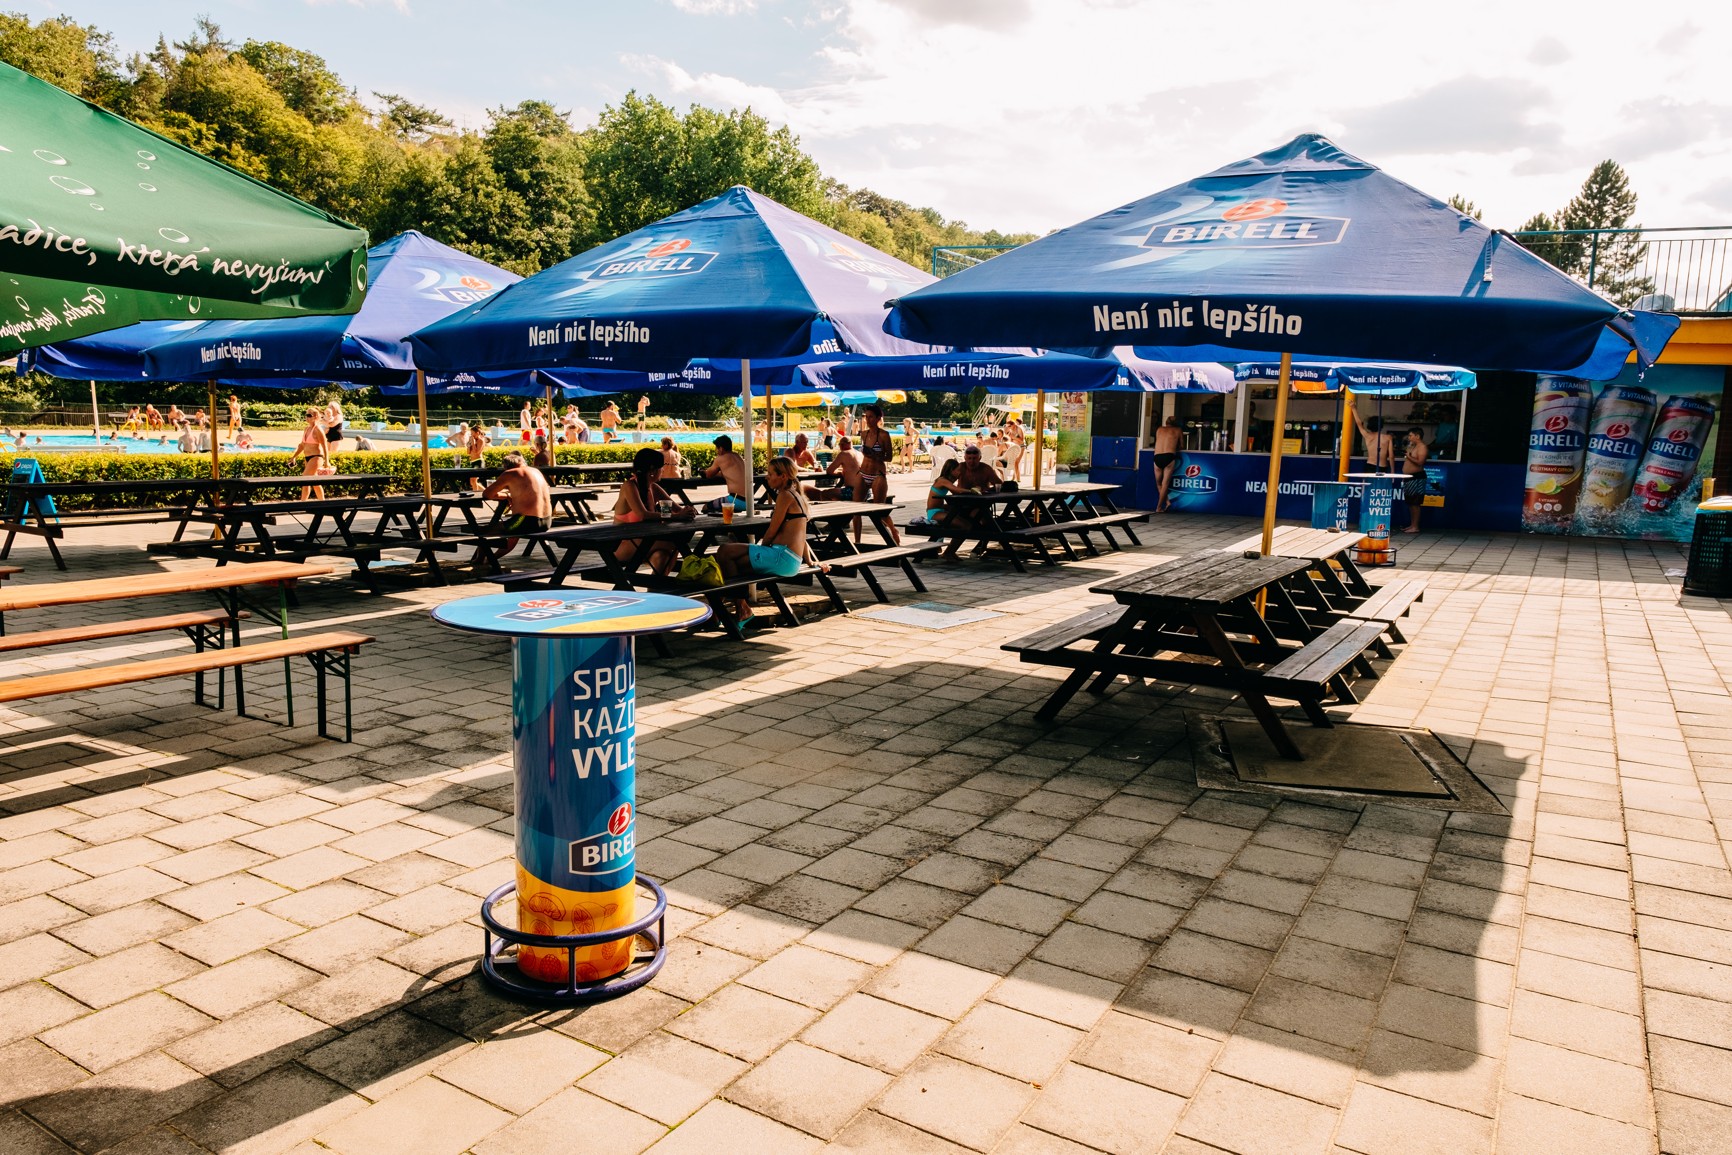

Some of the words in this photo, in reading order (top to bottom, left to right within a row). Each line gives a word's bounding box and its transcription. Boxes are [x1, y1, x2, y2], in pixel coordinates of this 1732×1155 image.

[1162, 222, 1321, 243] BIRELL
[117, 237, 210, 273] která
[212, 257, 332, 294] nevyšumí
[599, 256, 695, 277] BIRELL
[448, 290, 492, 302] BIR
[1093, 302, 1149, 332] Není
[1157, 300, 1194, 328] nic
[1202, 299, 1303, 338] lepšího
[528, 321, 561, 347] Není
[564, 320, 587, 344] nic
[590, 319, 650, 350] lepšího
[200, 344, 216, 364] Není
[229, 341, 262, 363] lepšího
[922, 364, 947, 378] Není
[950, 363, 965, 377] nic
[968, 363, 1010, 380] lepšího
[1293, 368, 1319, 379] lepšího
[1366, 375, 1378, 383] nic
[1379, 375, 1406, 385] lepšího
[1529, 434, 1581, 447] BIRELL
[1588, 437, 1637, 456] BIRELL
[1651, 440, 1694, 459] BIRELL
[1172, 478, 1212, 490] BIRELL
[1245, 480, 1315, 496] NEAKOHOL
[515, 599, 629, 619] BILL
